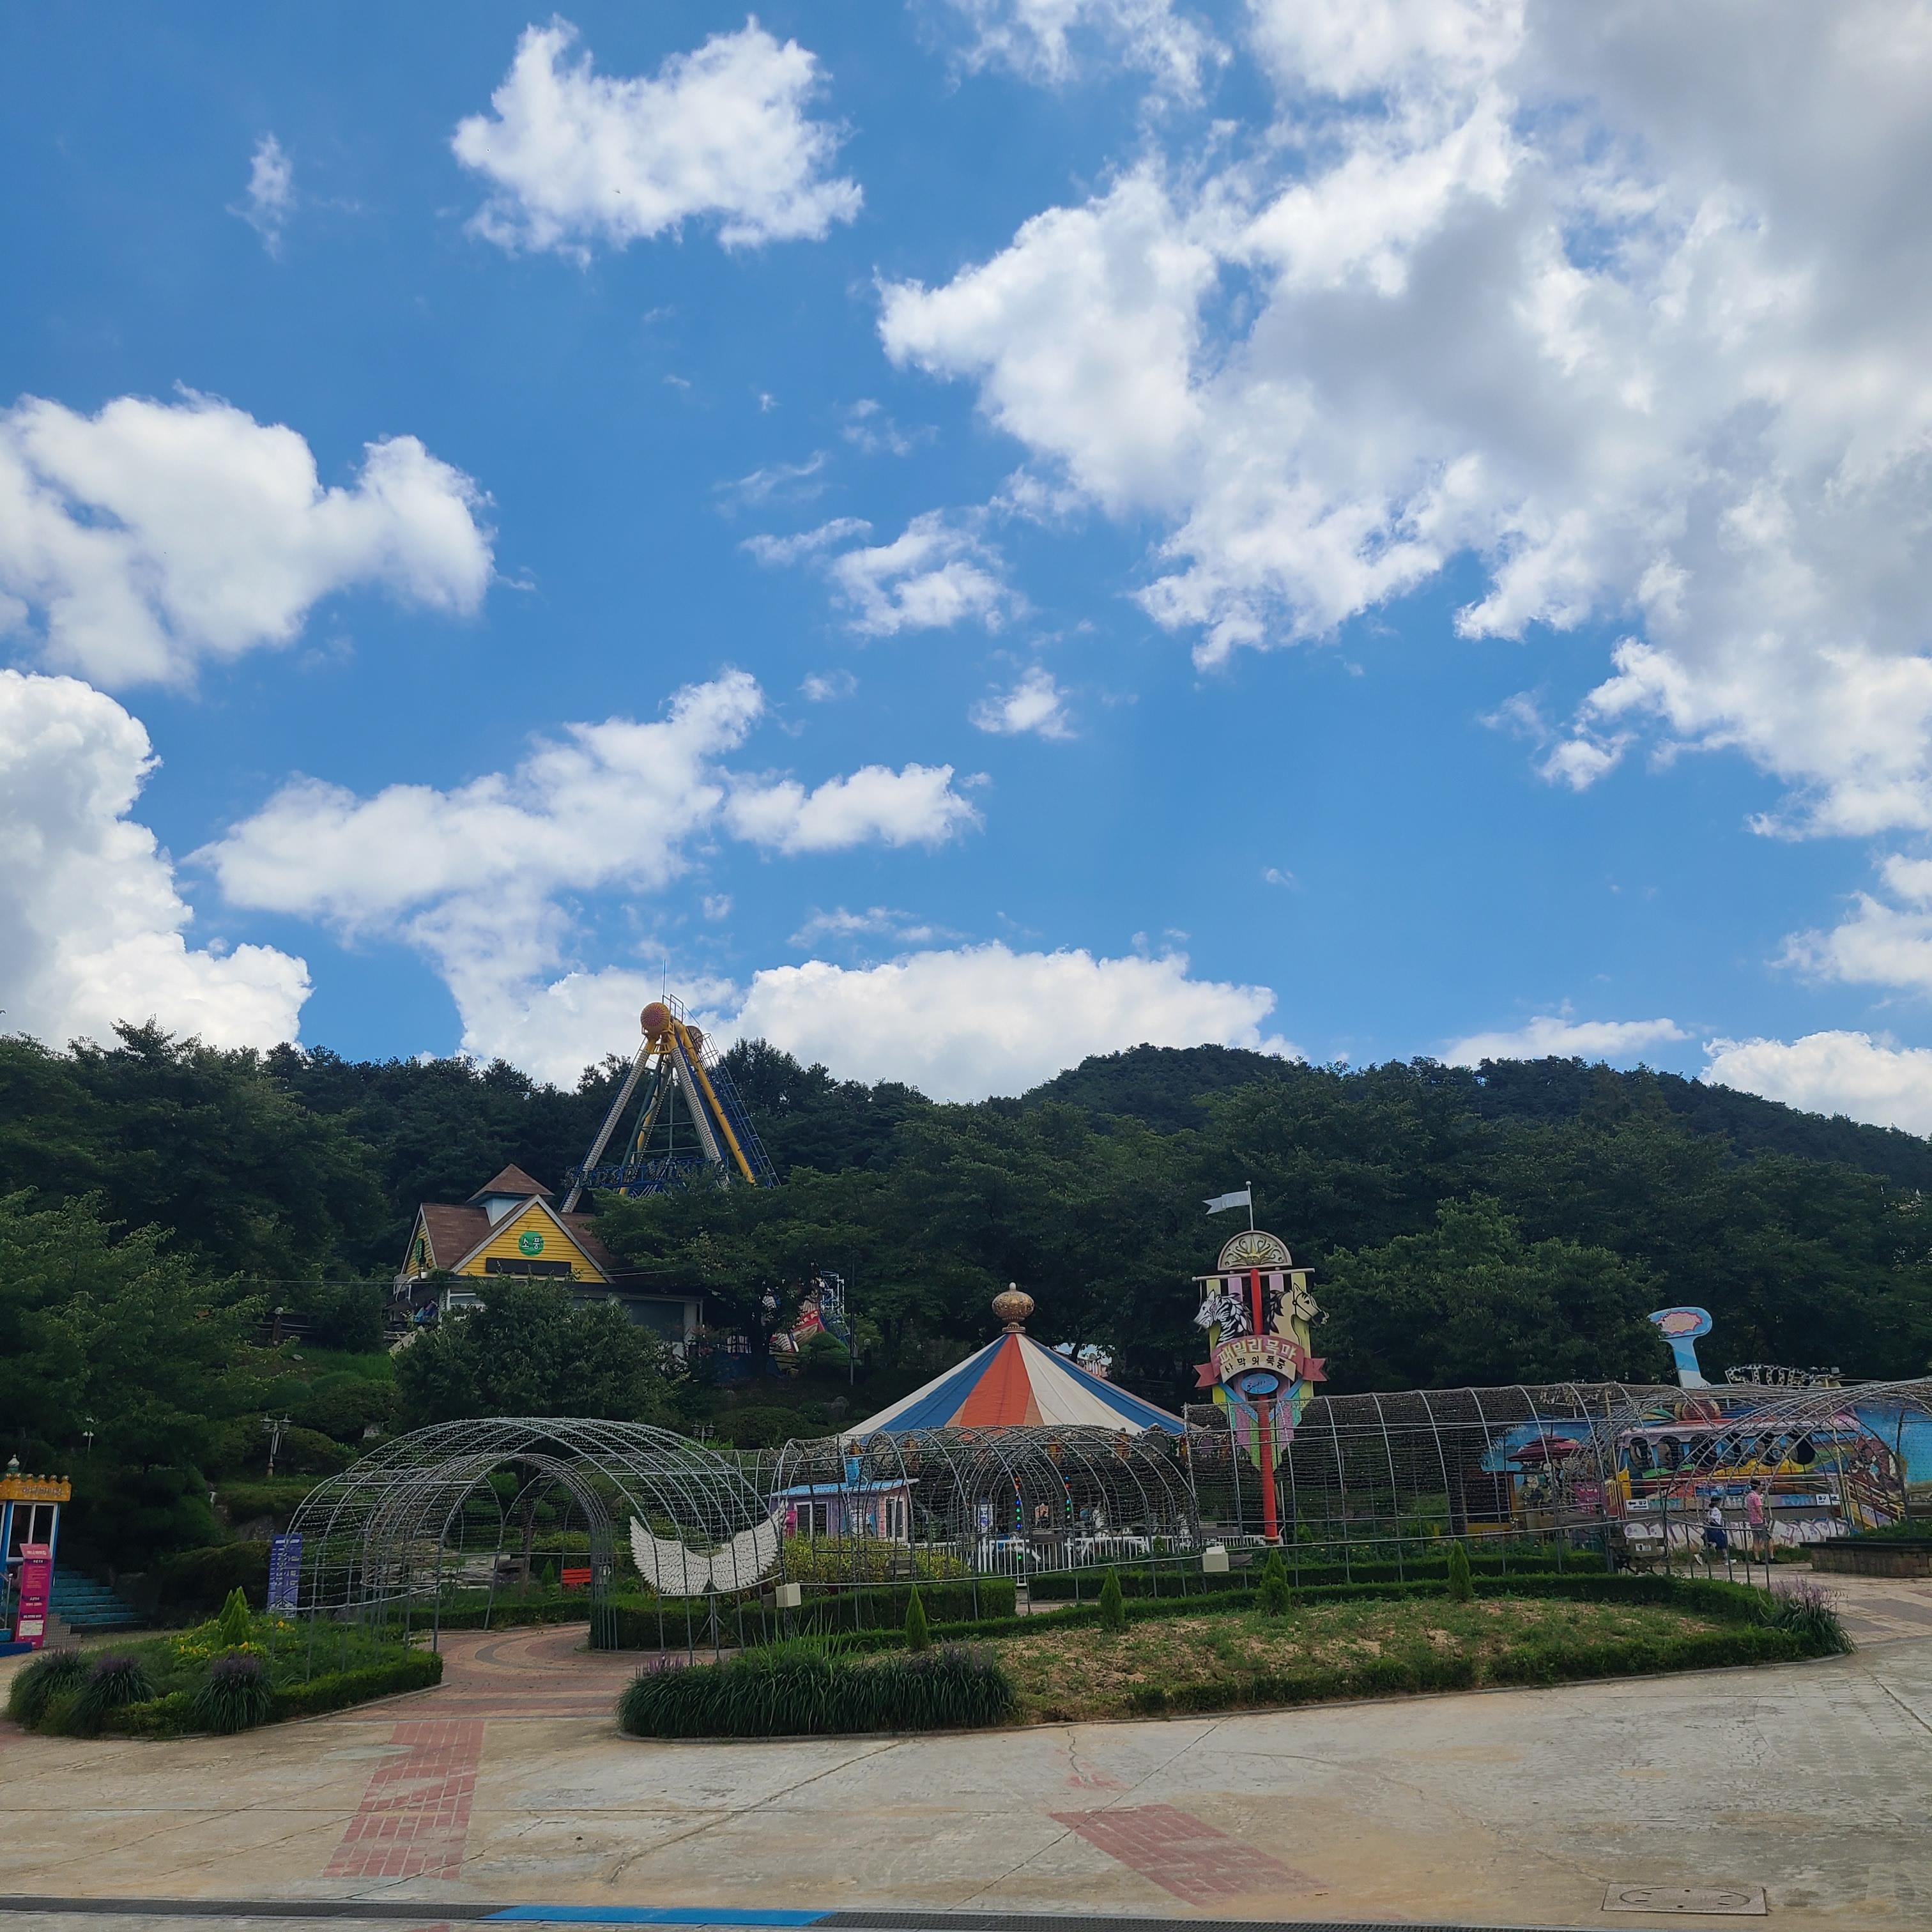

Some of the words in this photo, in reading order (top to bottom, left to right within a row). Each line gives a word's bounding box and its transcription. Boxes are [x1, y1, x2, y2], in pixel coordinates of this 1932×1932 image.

[521, 1238, 540, 1250] 소풍
[1217, 1338, 1262, 1364] 패밀리
[1266, 1340, 1297, 1360] 목마
[1225, 1356, 1259, 1373] 사막의
[1266, 1355, 1286, 1370] 폭풍
